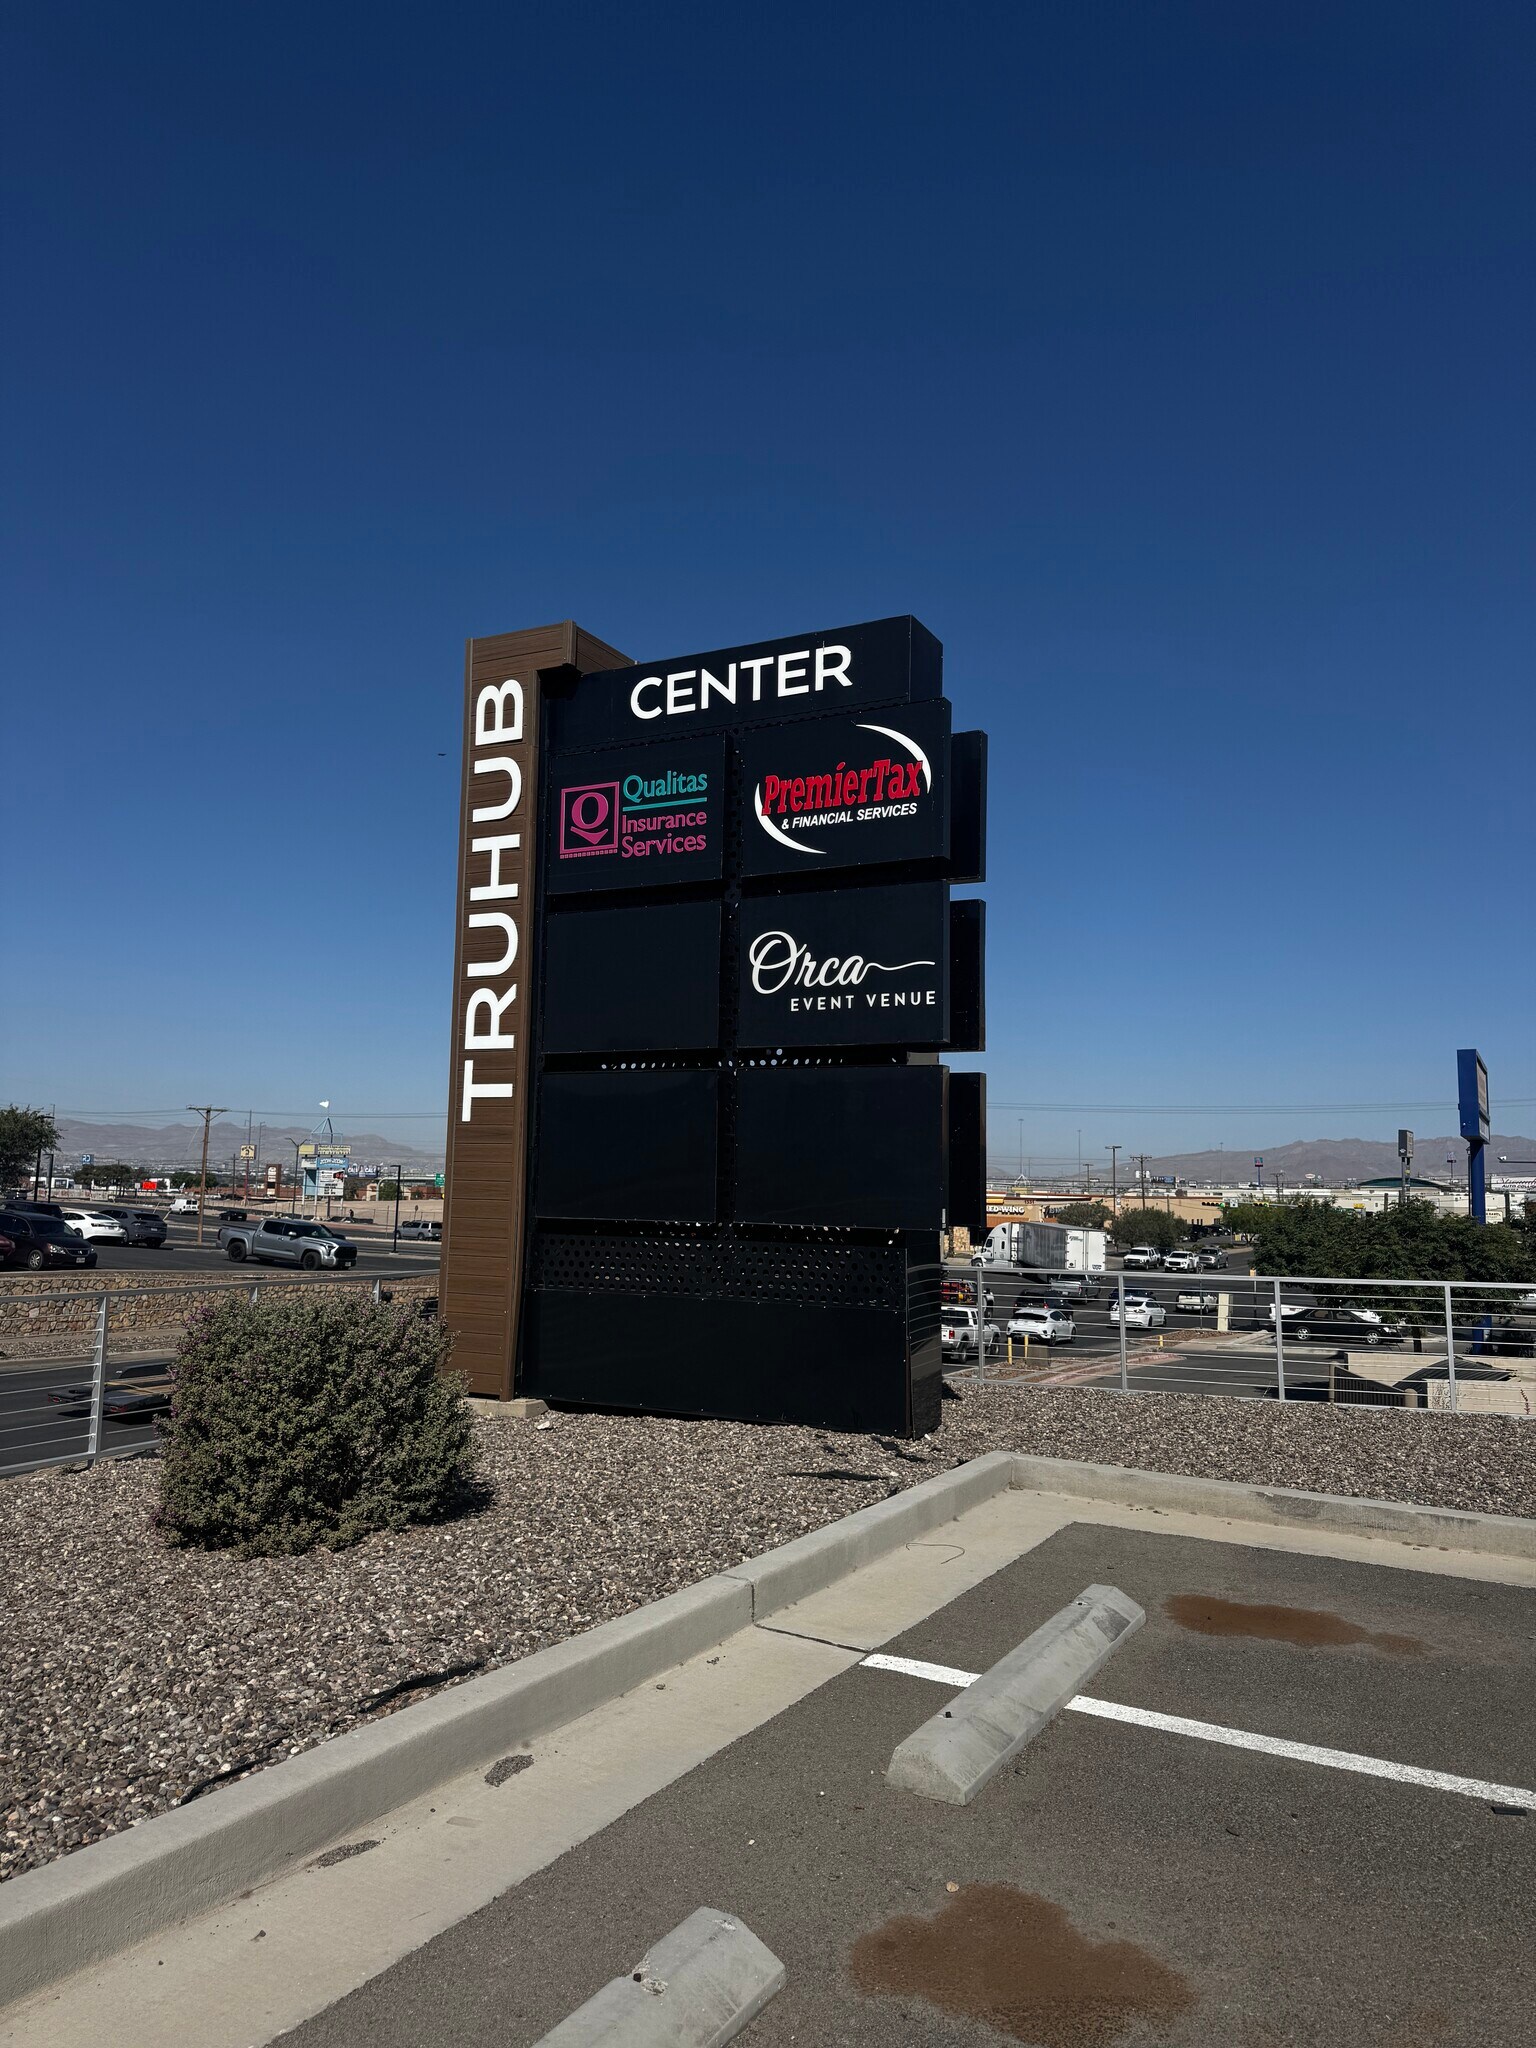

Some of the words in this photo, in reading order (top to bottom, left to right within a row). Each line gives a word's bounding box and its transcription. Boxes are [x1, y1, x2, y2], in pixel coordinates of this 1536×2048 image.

[630, 645, 853, 720] CENTER
[622, 770, 708, 803] Qualitas
[621, 810, 708, 834] Insurance
[781, 818, 790, 831] &
[792, 812, 854, 829] FINANCIAL
[857, 803, 918, 821] SERVICES
[621, 832, 707, 859] Services
[461, 679, 524, 1123] TRUHUB
[748, 930, 936, 995] Orca
[790, 994, 855, 1012] EVENT
[865, 990, 937, 1007] VENUE
